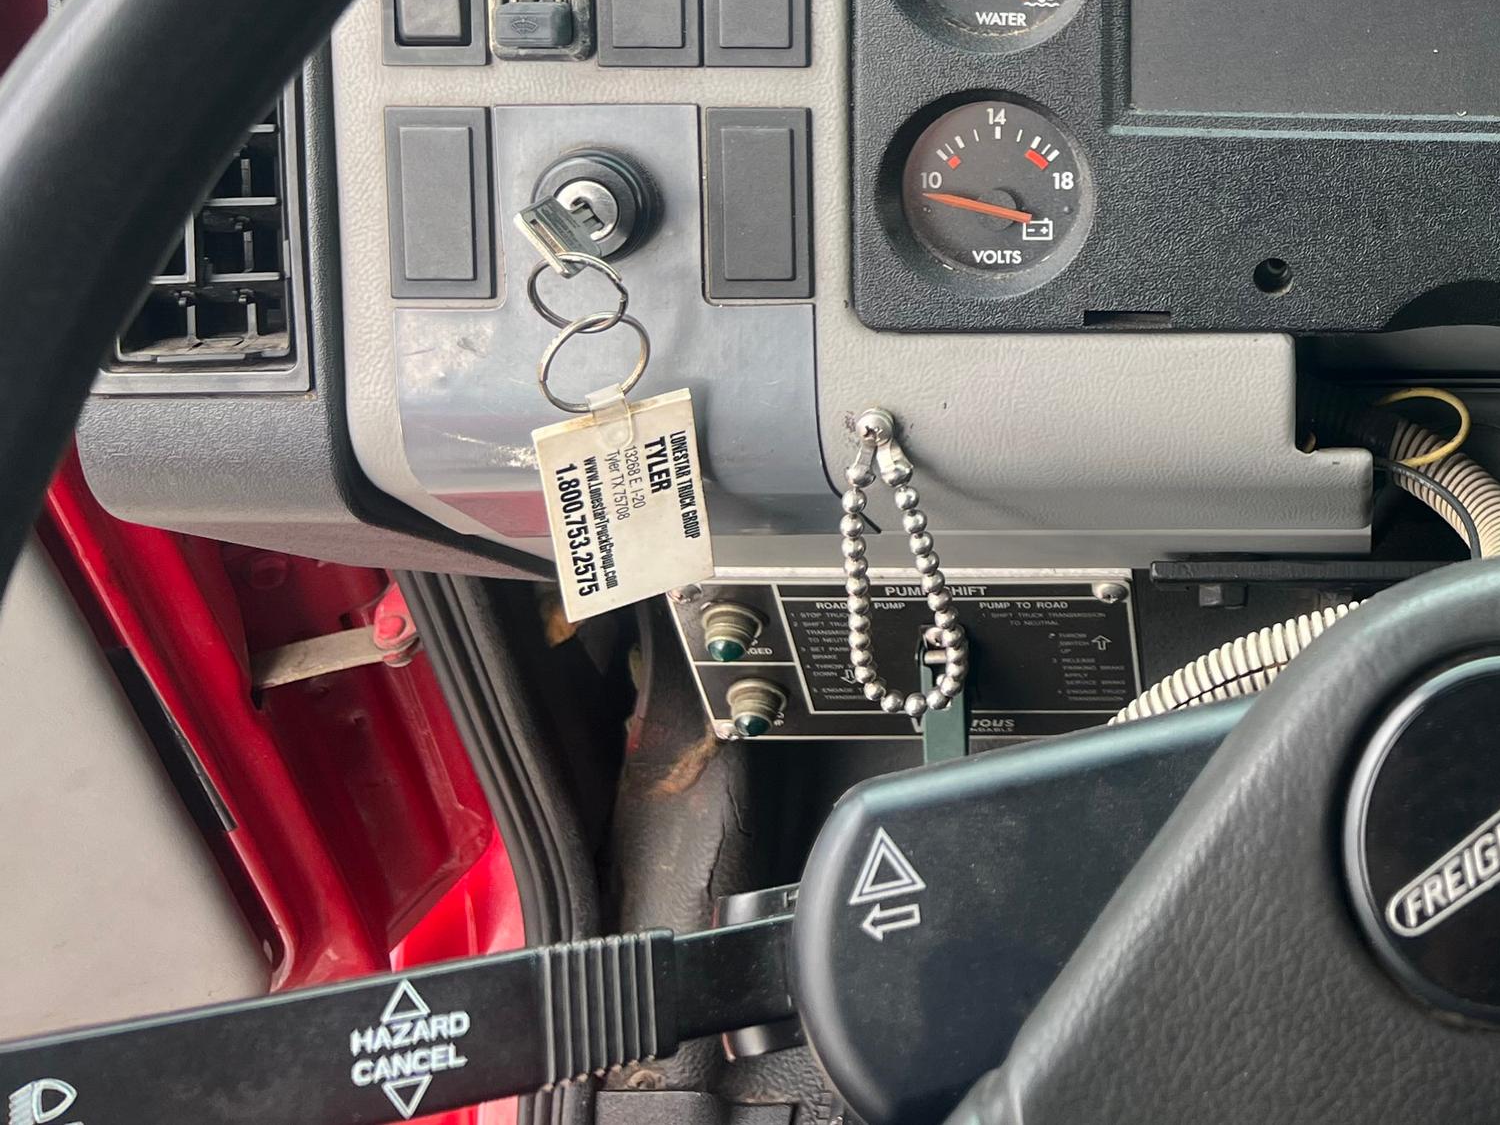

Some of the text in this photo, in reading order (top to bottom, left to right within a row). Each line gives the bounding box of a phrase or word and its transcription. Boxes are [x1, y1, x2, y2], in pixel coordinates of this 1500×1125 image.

[976, 11, 1026, 27] WATER
[987, 108, 1007, 125] 14
[920, 172, 942, 189] 10
[1052, 172, 1074, 190] 18
[972, 250, 1022, 264] VOLTS
[624, 446, 640, 476] 13268
[645, 436, 672, 494] TYLER
[604, 449, 630, 521] Tyler TX 75708
[670, 430, 701, 539] LONESTAR TRUCK GROUP
[555, 463, 600, 597] 1.800.753.2575
[583, 456, 618, 589] www.LonestarTruckGroup.com
[874, 602, 905, 610] PUMP
[979, 602, 1011, 610] PUMP
[349, 1011, 471, 1057] HAZARD
[350, 1042, 468, 1087] CANCEL
